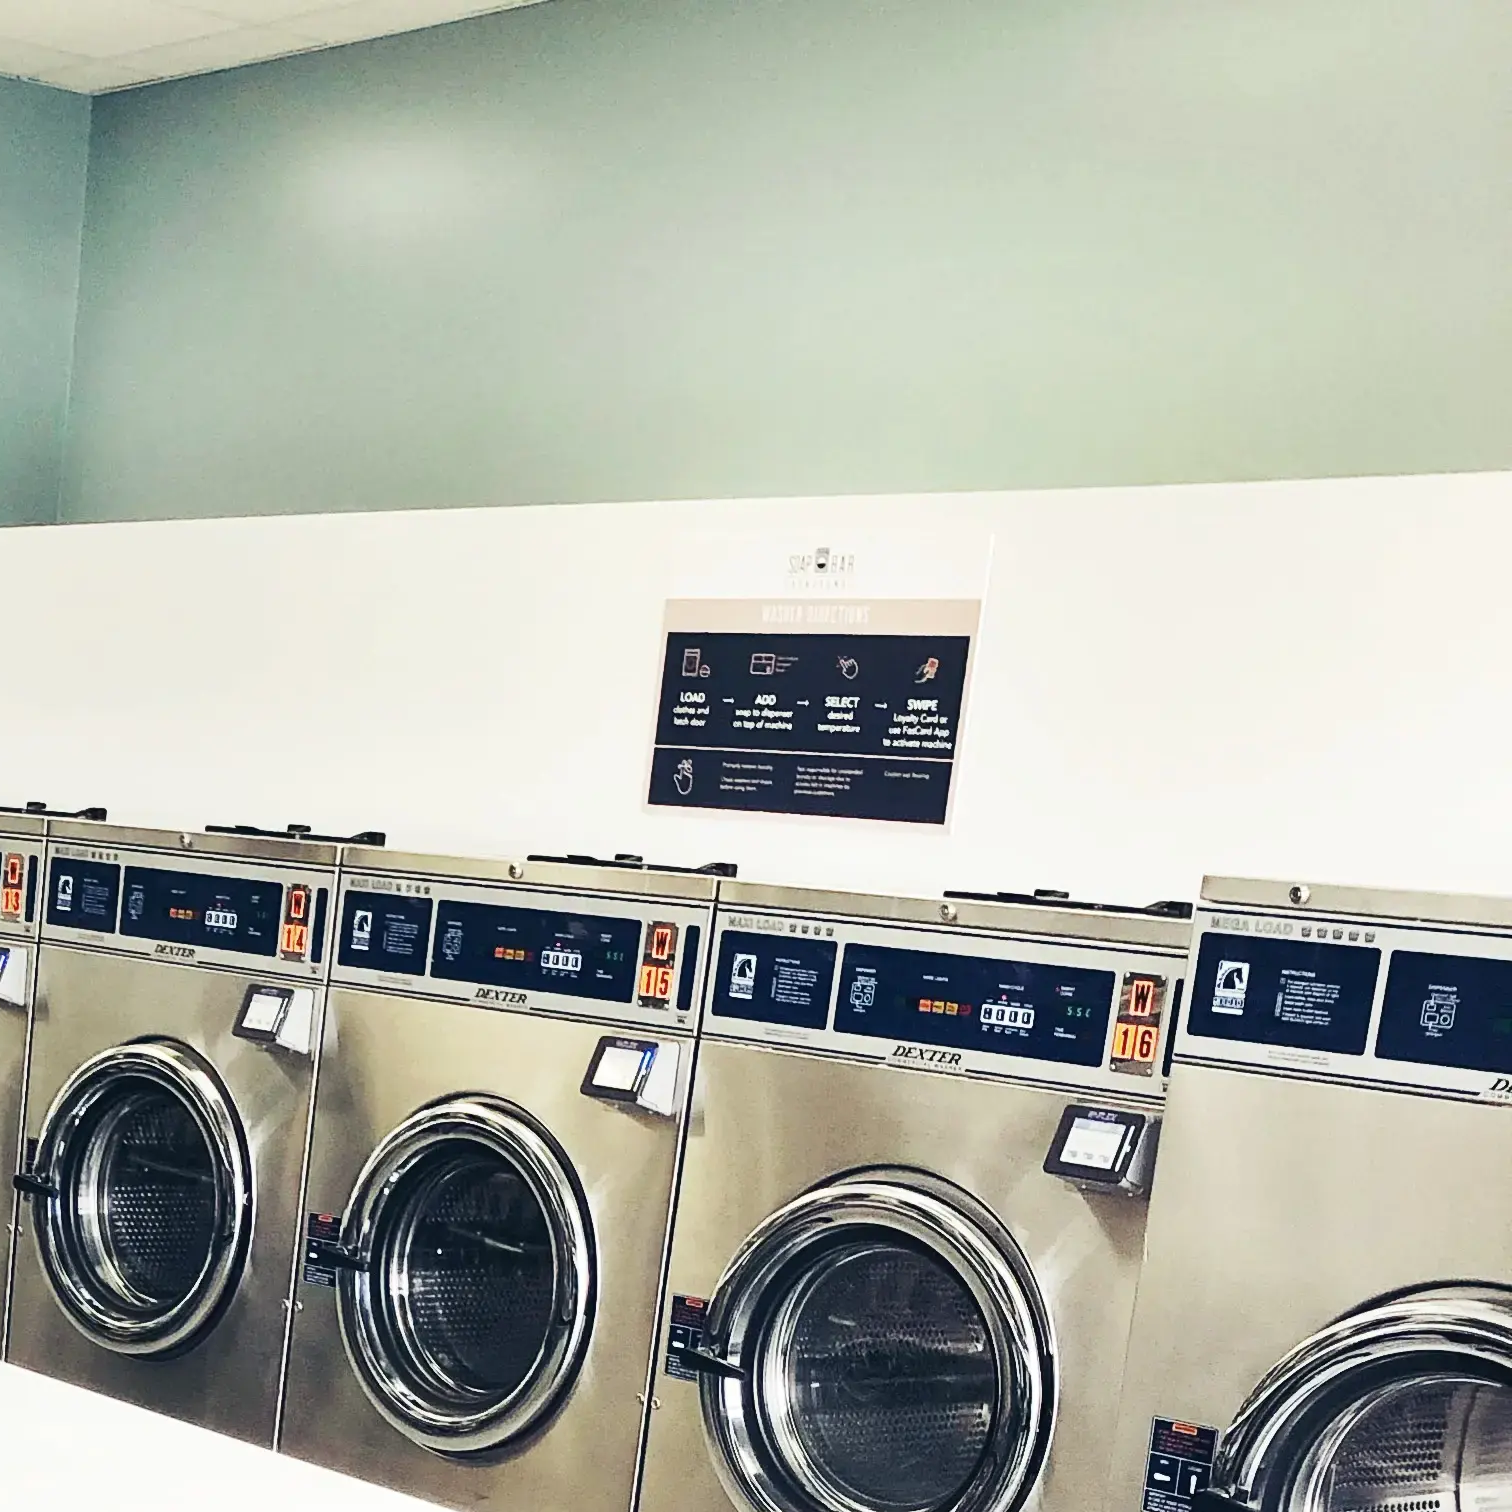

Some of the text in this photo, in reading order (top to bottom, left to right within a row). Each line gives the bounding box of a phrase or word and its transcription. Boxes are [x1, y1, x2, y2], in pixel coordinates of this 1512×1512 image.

[680, 691, 706, 703] LOAD
[754, 694, 777, 706] ADD
[824, 696, 861, 708] SELECT
[906, 698, 939, 711] SWIPE
[4, 891, 20, 911] 13
[1210, 915, 1294, 936] MEGA LOAD
[284, 926, 305, 951] 14
[655, 931, 669, 957] W
[154, 943, 196, 959] DEXTER
[644, 971, 671, 997] 15
[474, 987, 528, 1005] DEXTER
[1133, 983, 1152, 1014] W
[1119, 1027, 1154, 1060] 16
[891, 1045, 963, 1066] DEXTER
